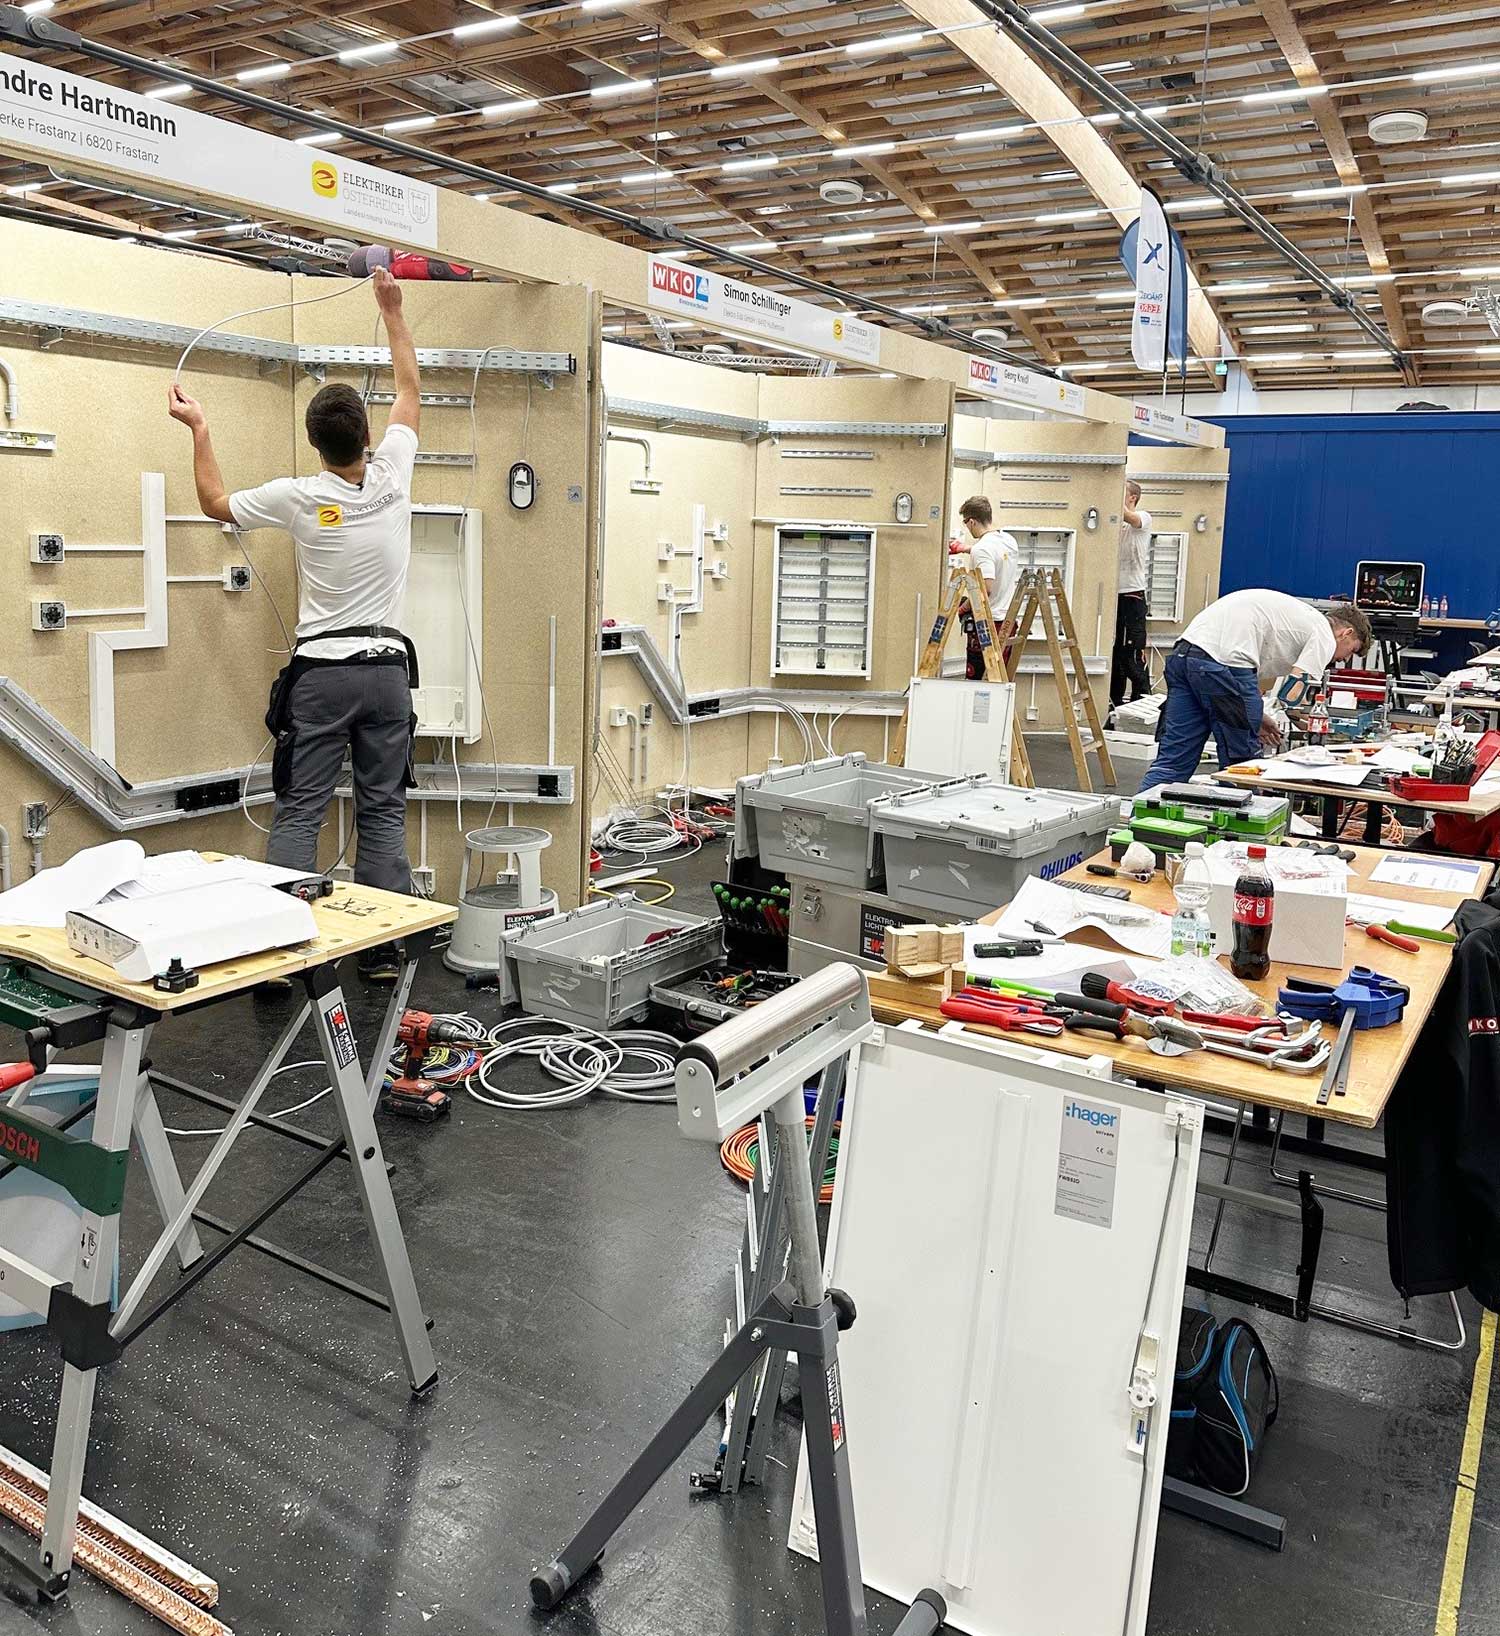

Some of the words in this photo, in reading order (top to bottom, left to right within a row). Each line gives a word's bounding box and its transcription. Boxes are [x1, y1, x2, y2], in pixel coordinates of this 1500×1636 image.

[61, 83, 177, 137] Hartmann
[28, 118, 77, 143] Frastanz
[86, 134, 113, 152] 6820
[115, 142, 160, 165] Frastanz
[343, 172, 404, 199] ELEKTRIKER
[653, 264, 694, 296] WKO
[723, 283, 750, 303] Simon
[751, 292, 792, 316] Schillinger
[971, 361, 990, 380] WKO
